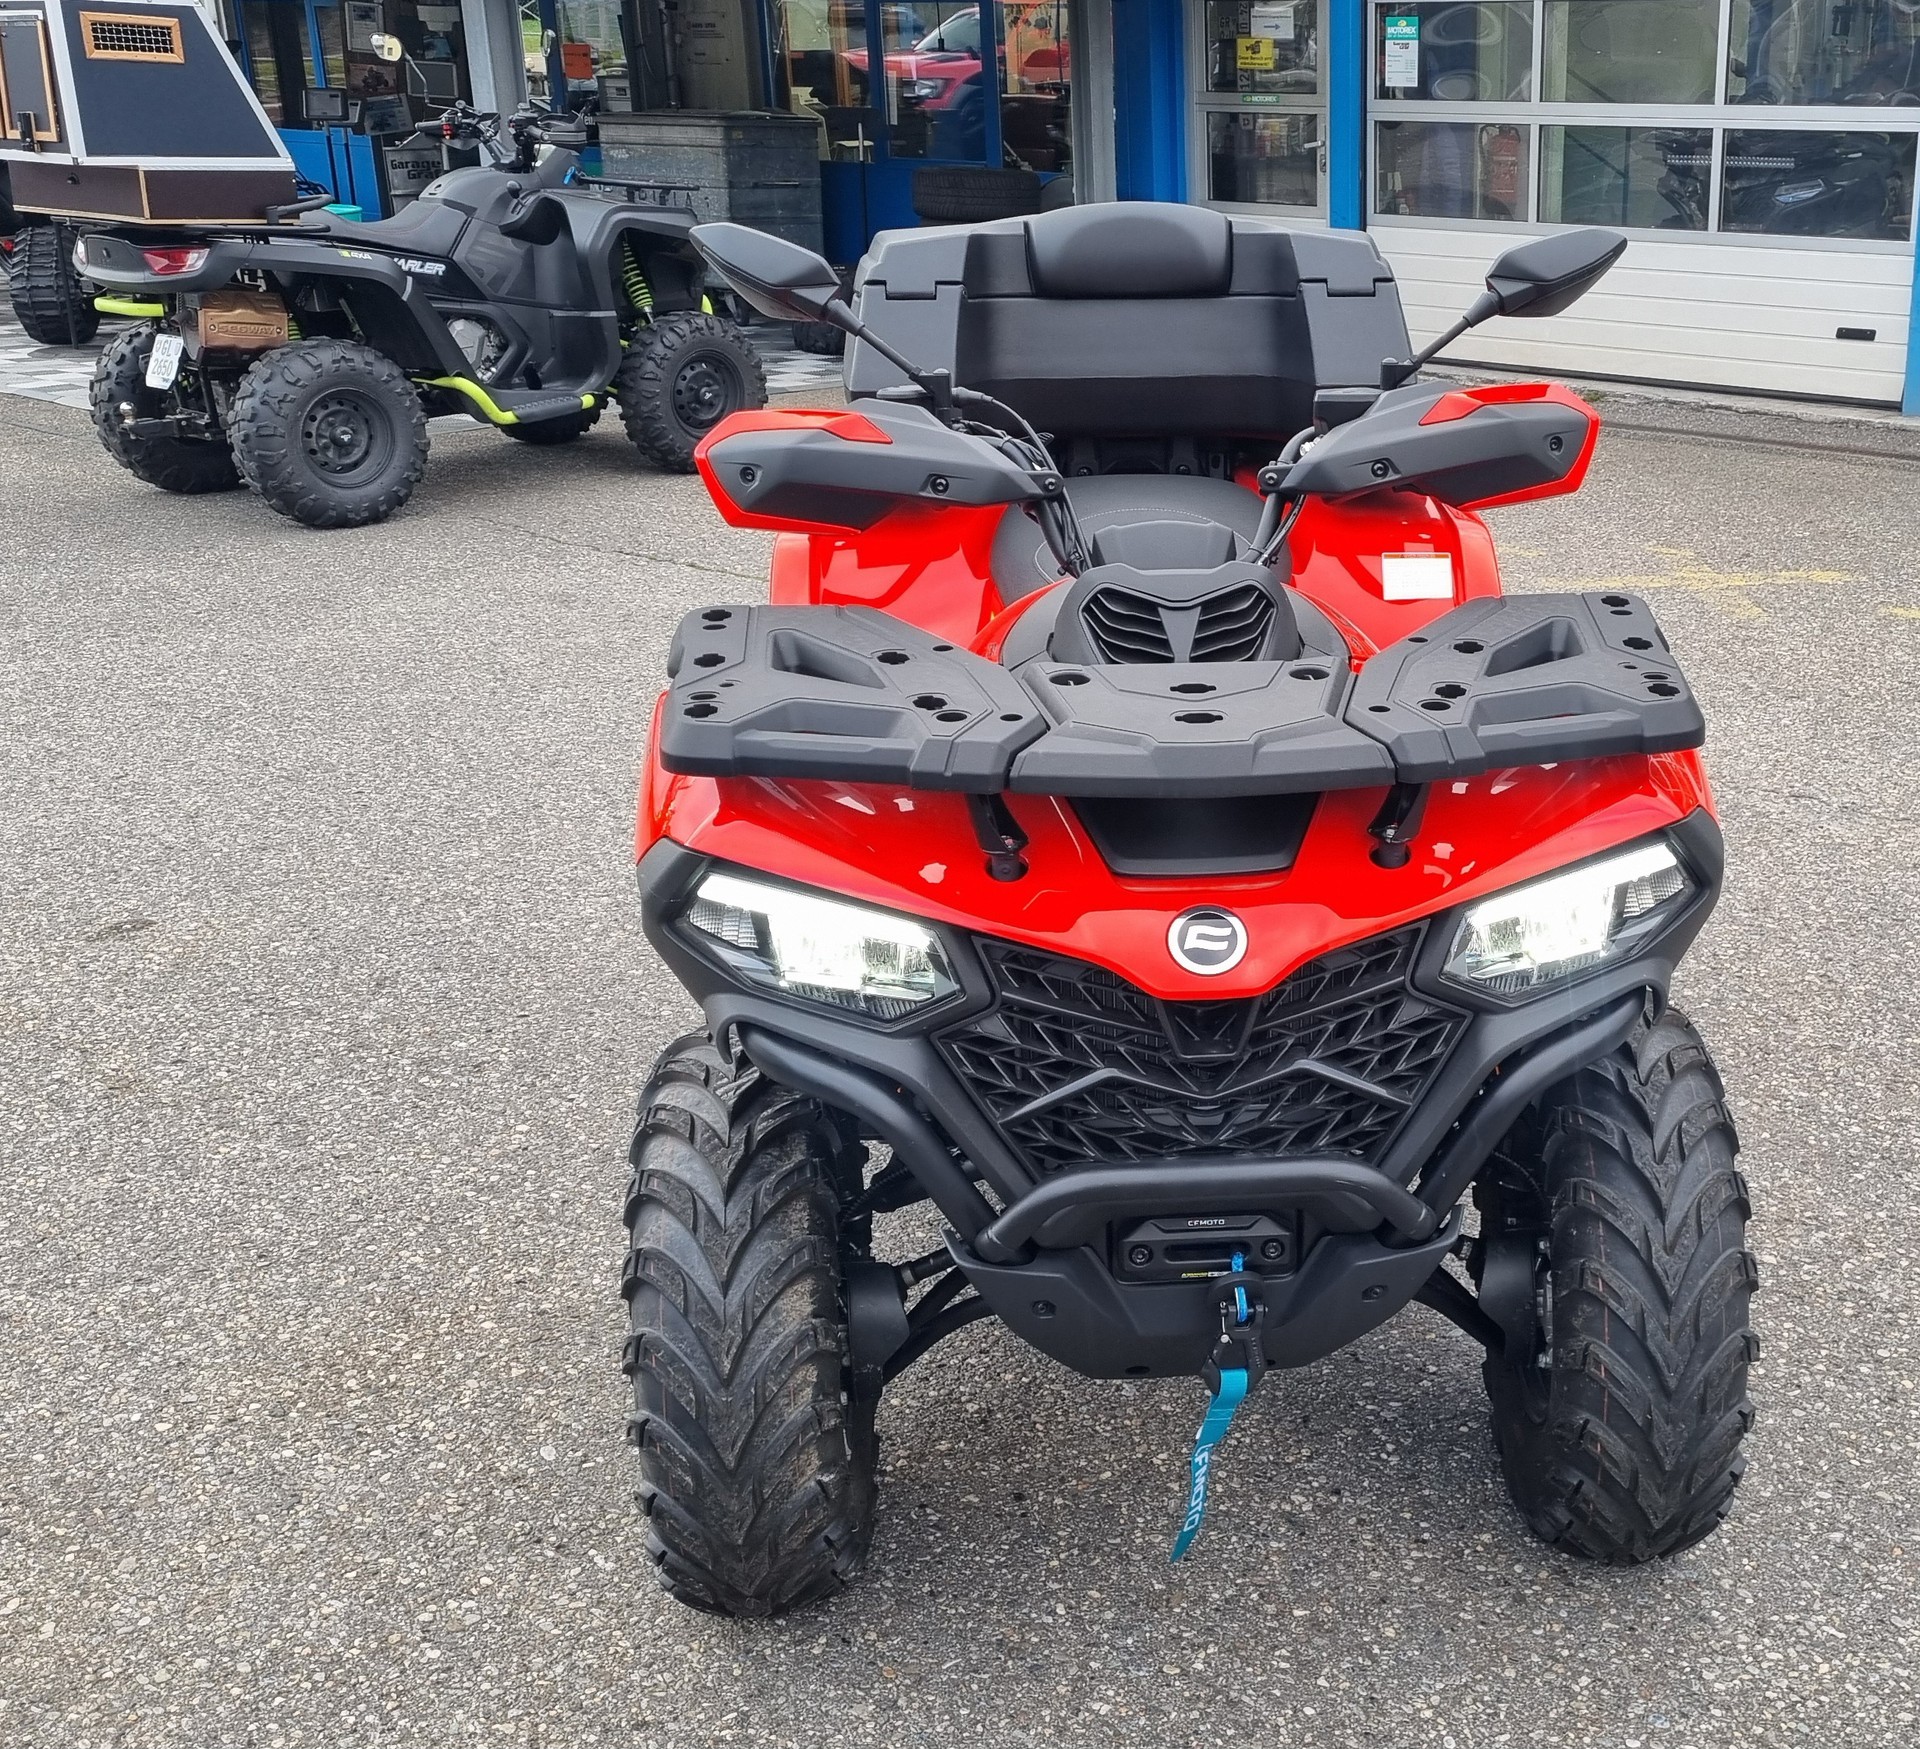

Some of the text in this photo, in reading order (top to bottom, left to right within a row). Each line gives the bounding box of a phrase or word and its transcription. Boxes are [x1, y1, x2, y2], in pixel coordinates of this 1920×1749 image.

[1387, 26, 1416, 35] MOTOREX
[390, 159, 442, 171] Garage
[393, 257, 446, 276] ARLER
[218, 325, 275, 335] SEGWAY
[151, 358, 173, 377] 2650
[1187, 1219, 1225, 1227] CFMOTO
